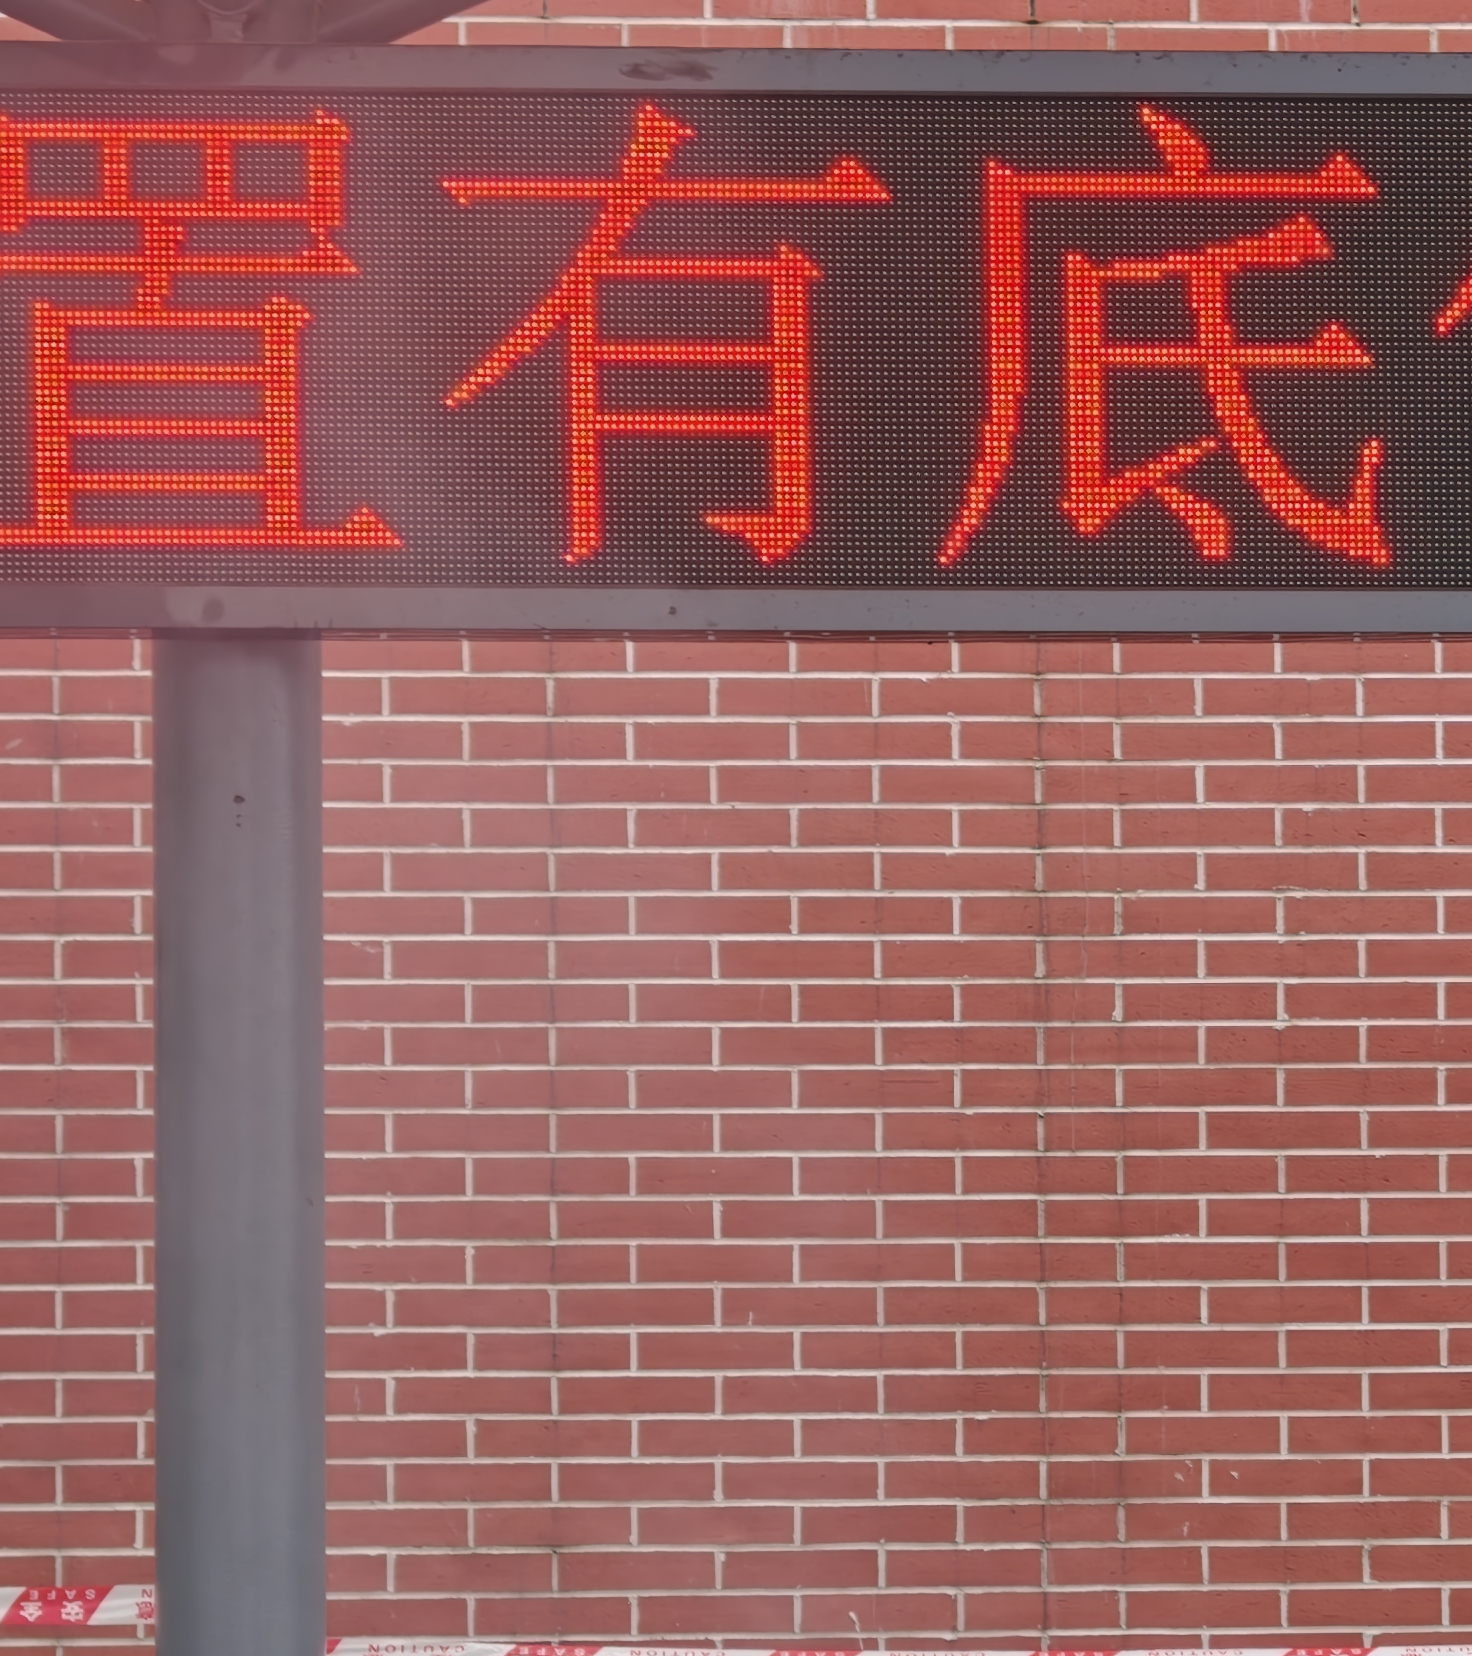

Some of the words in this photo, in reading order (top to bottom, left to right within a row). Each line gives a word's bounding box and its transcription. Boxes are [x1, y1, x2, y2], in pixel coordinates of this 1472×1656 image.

[29, 1589, 96, 1600] SAFE
[20, 1601, 85, 1621] 安全
[368, 1643, 465, 1655] CAUTION
[516, 1646, 585, 1656] SAFE
